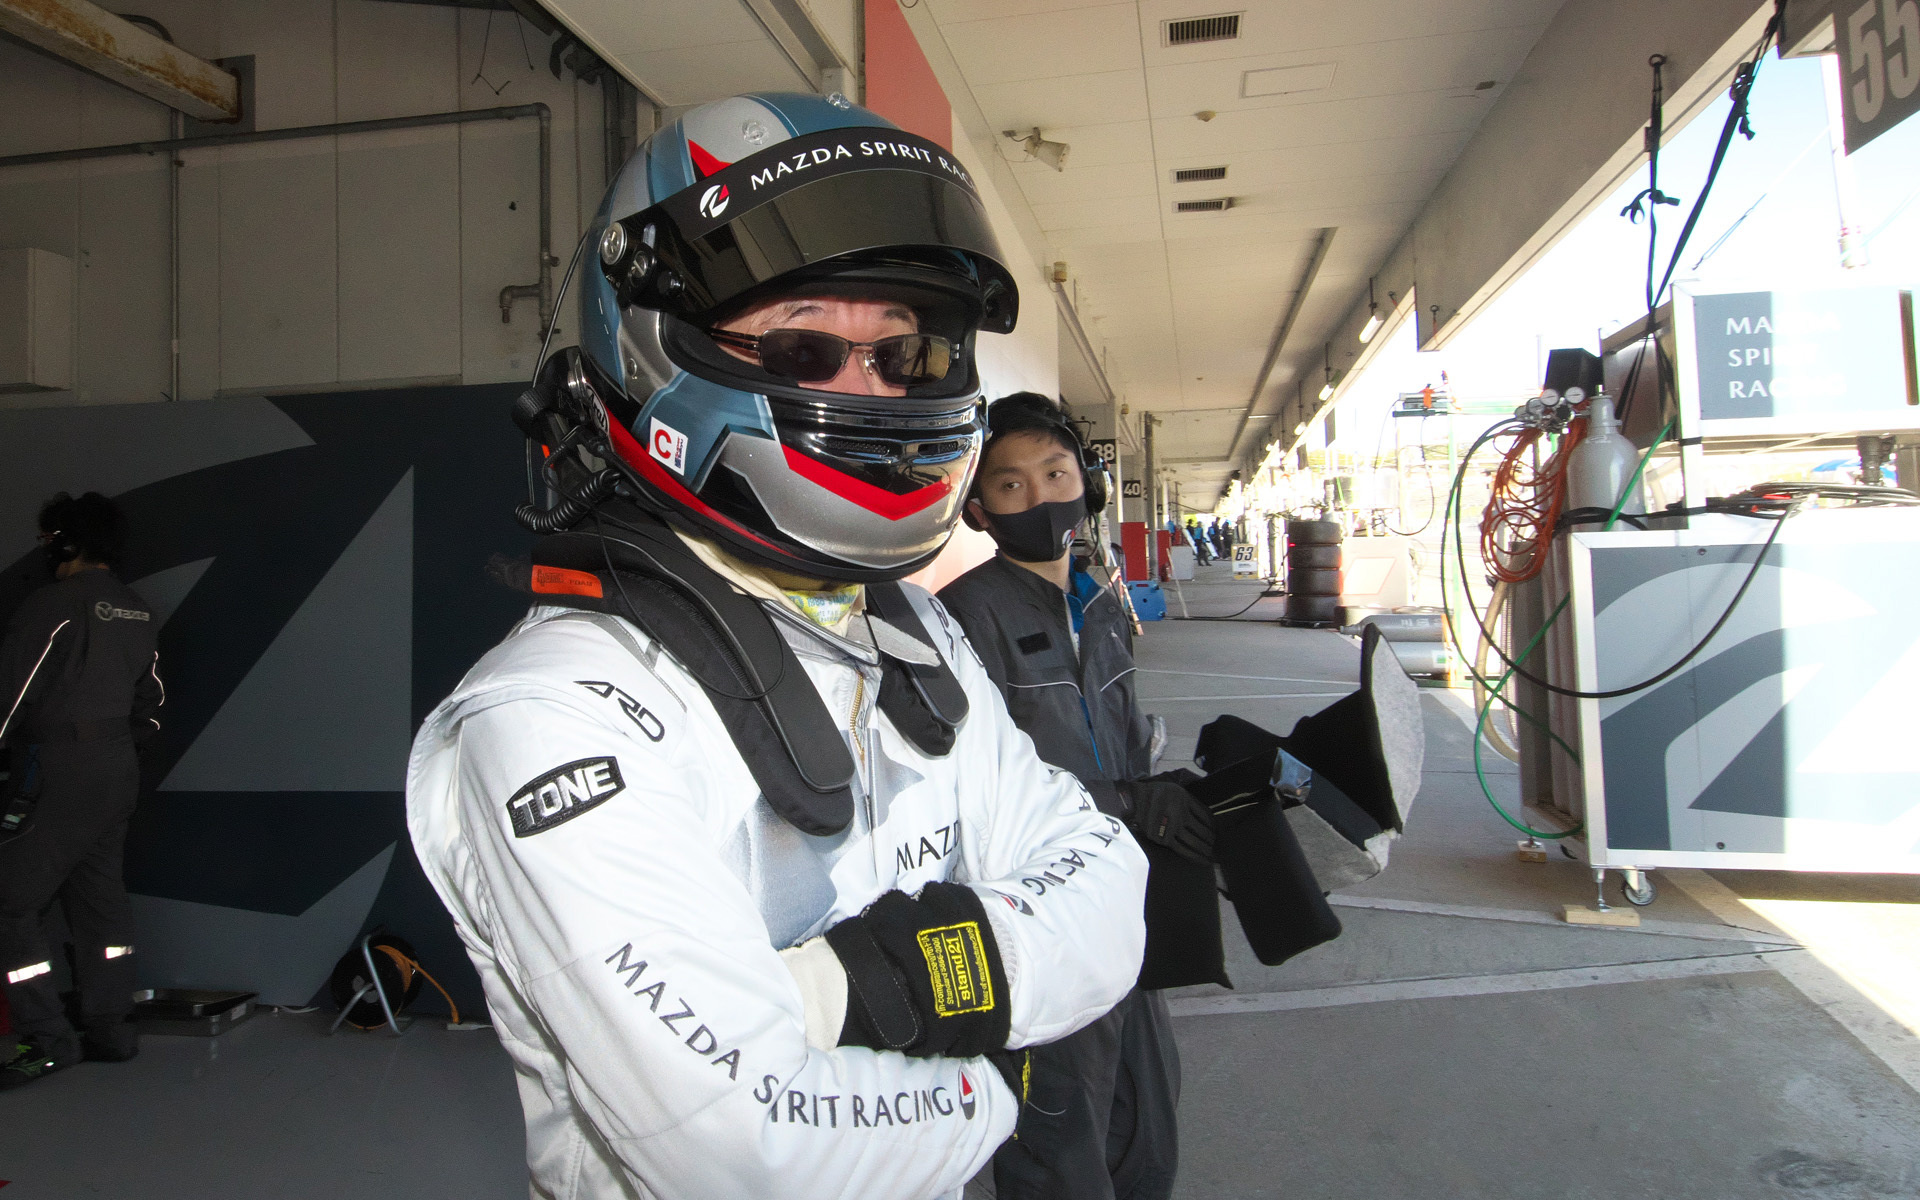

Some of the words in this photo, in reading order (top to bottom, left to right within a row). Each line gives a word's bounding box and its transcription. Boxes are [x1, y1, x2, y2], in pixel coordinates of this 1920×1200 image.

[1847, 0, 1920, 124] 55
[750, 143, 853, 191] MAZDA
[859, 140, 933, 164] SPIRIT
[938, 156, 977, 194] RAC
[654, 428, 672, 459] C
[1123, 482, 1140, 496] 40
[1235, 546, 1254, 561] 63
[572, 680, 665, 743] ARD
[512, 760, 618, 829] TONE
[604, 942, 741, 1081] MAZDA
[753, 1073, 841, 1129] SIRIT
[852, 1086, 954, 1128] RACING
